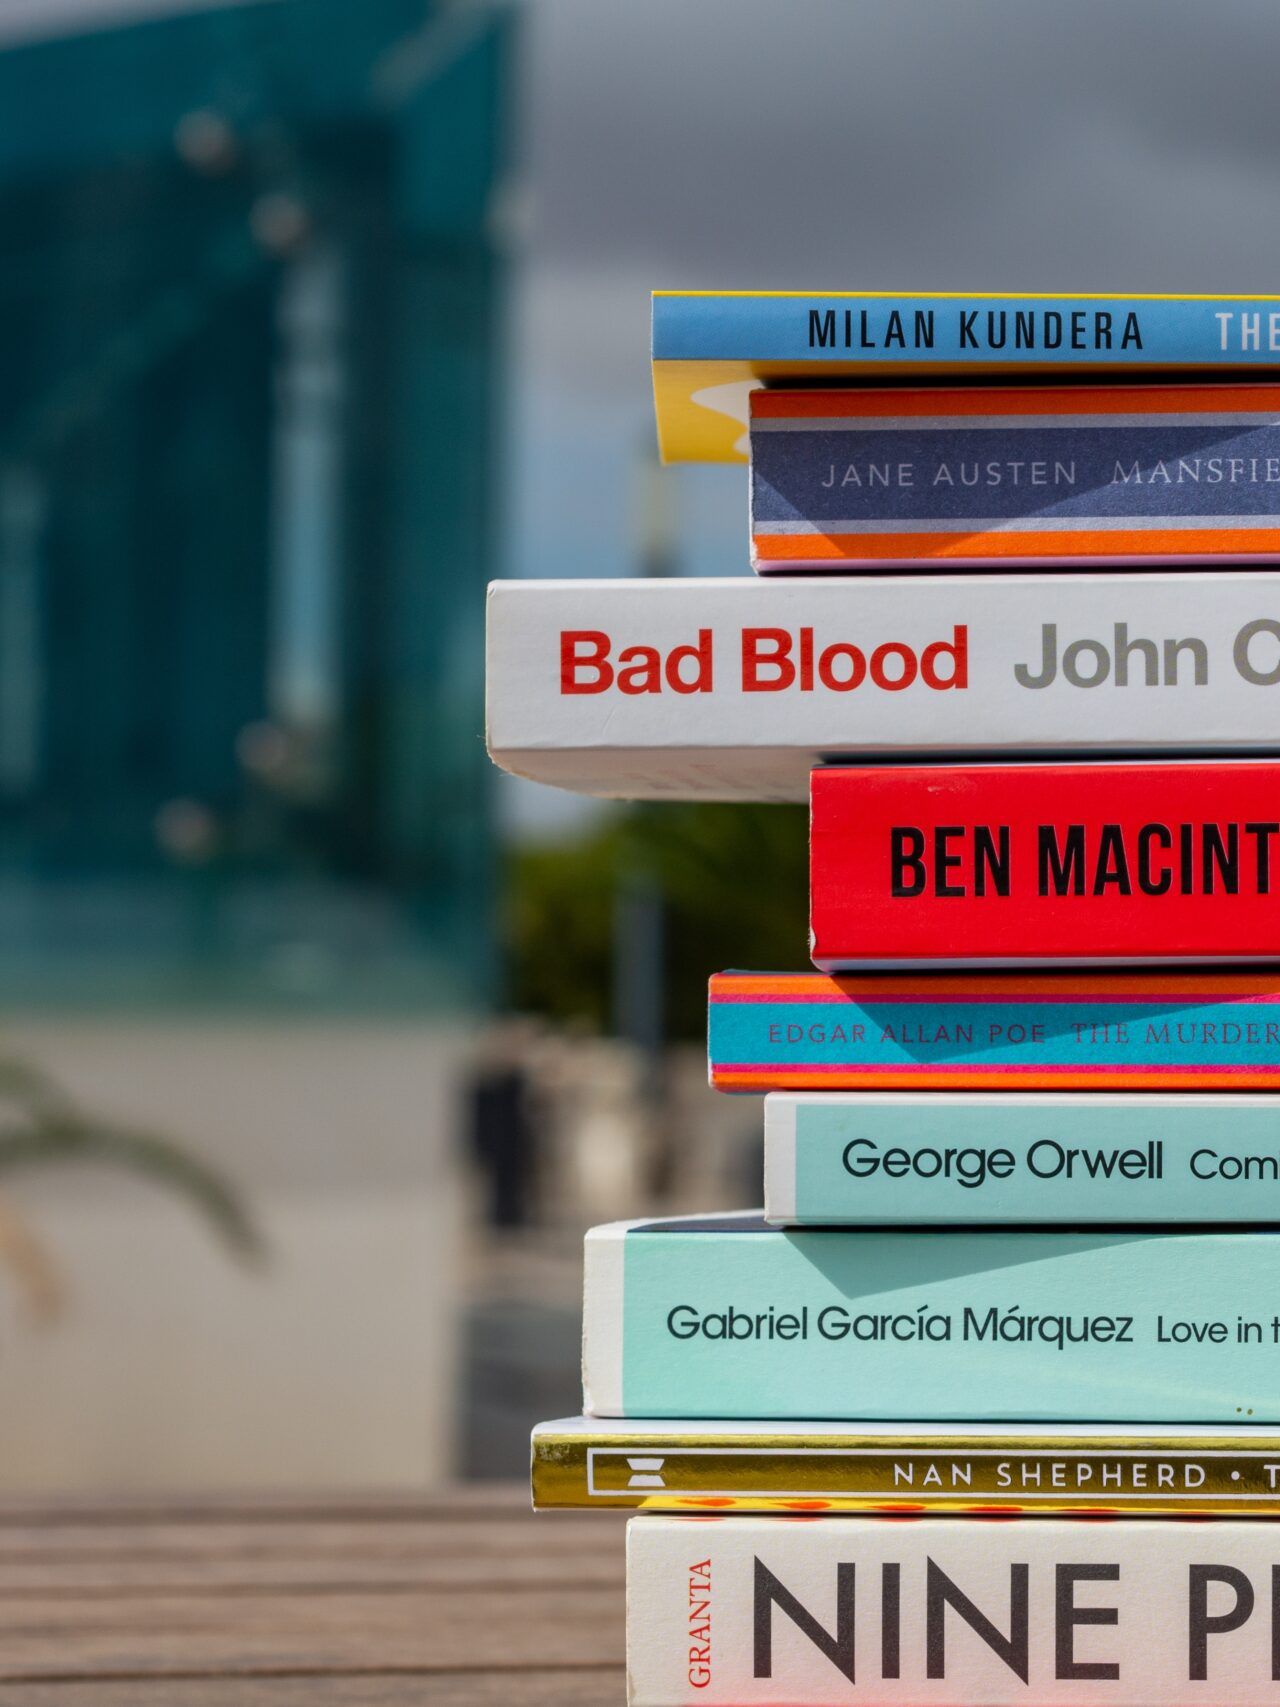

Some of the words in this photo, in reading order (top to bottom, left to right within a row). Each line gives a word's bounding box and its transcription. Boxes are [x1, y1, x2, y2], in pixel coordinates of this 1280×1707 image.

[809, 309, 934, 349] MILAN
[959, 311, 1143, 350] KUNDERA
[821, 463, 914, 488] JANE
[932, 461, 1076, 486] AUSTEN
[560, 628, 713, 695] Bad
[741, 624, 968, 692] Blood
[1014, 622, 1209, 690] John
[891, 825, 1010, 898] BEN
[767, 1023, 866, 1044] EDGAR
[879, 1023, 973, 1044] ALLAN
[988, 1023, 1045, 1044] POE
[1071, 1022, 1129, 1045] THE
[842, 1138, 1016, 1189] George
[1026, 1139, 1163, 1180] Orwell
[666, 1304, 808, 1341] Gabriel
[817, 1304, 952, 1342] García
[963, 1305, 1134, 1351] Márquez
[1157, 1315, 1229, 1344] Love
[1237, 1316, 1263, 1343] in
[893, 1462, 973, 1486] NAN
[996, 1462, 1206, 1488] SHEPHERD
[688, 1559, 711, 1689] GRANTA
[753, 1555, 1120, 1686] NINE
